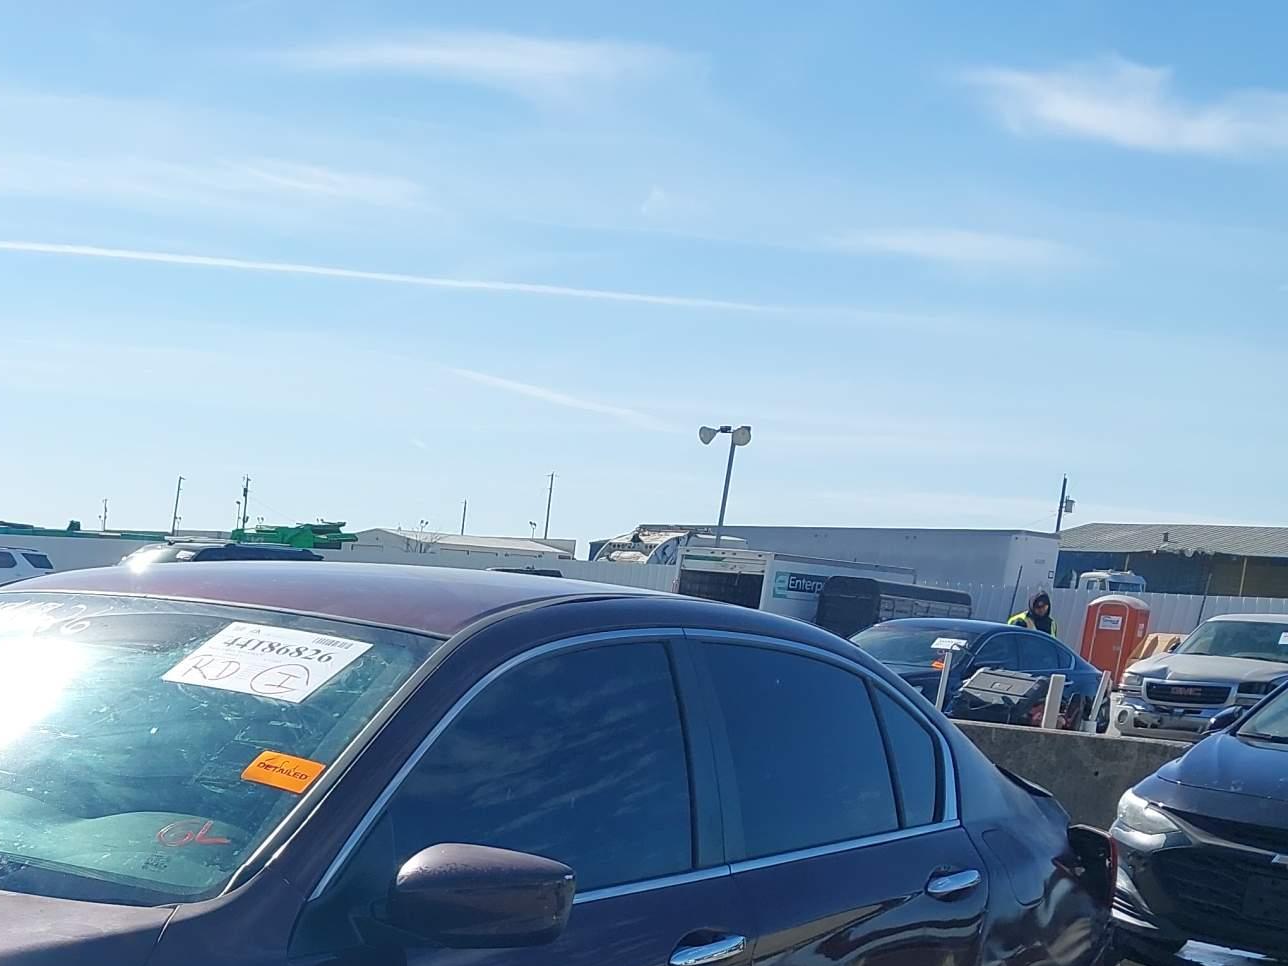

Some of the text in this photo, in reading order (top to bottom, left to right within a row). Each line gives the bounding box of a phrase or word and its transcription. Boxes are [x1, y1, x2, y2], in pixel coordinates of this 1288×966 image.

[788, 576, 825, 593] Enterp
[224, 636, 334, 663] 44186826
[257, 761, 309, 780] DETAILED
